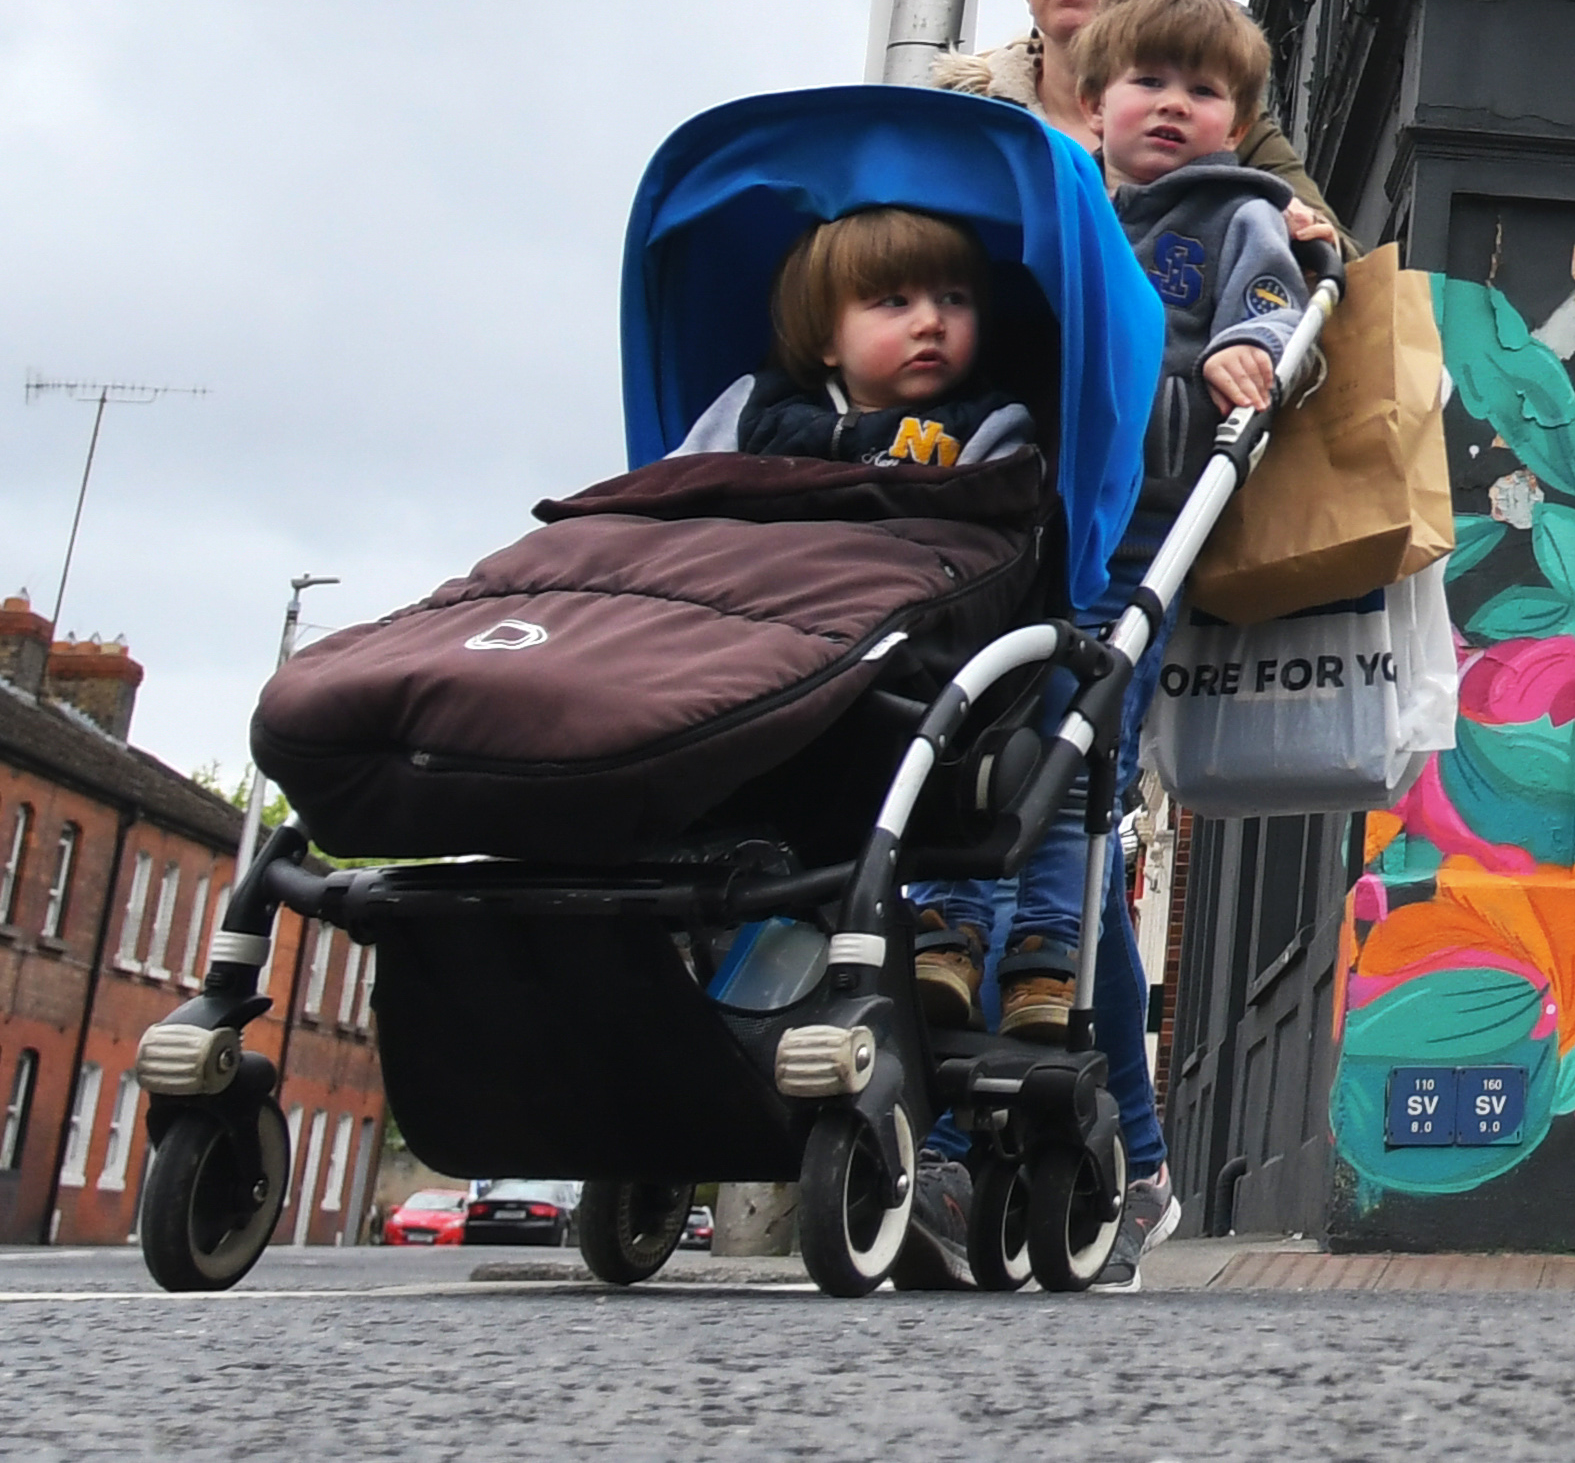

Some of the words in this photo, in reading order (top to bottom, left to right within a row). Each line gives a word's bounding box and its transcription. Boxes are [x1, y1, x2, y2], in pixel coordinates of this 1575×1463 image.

[1255, 655, 1345, 693] FOR
[1415, 1079, 1435, 1091] 110
[1407, 1095, 1440, 1115] SV
[1475, 1095, 1507, 1115] SV
[1411, 1121, 1433, 1133] 8.0
[1479, 1121, 1501, 1133] 9.0
